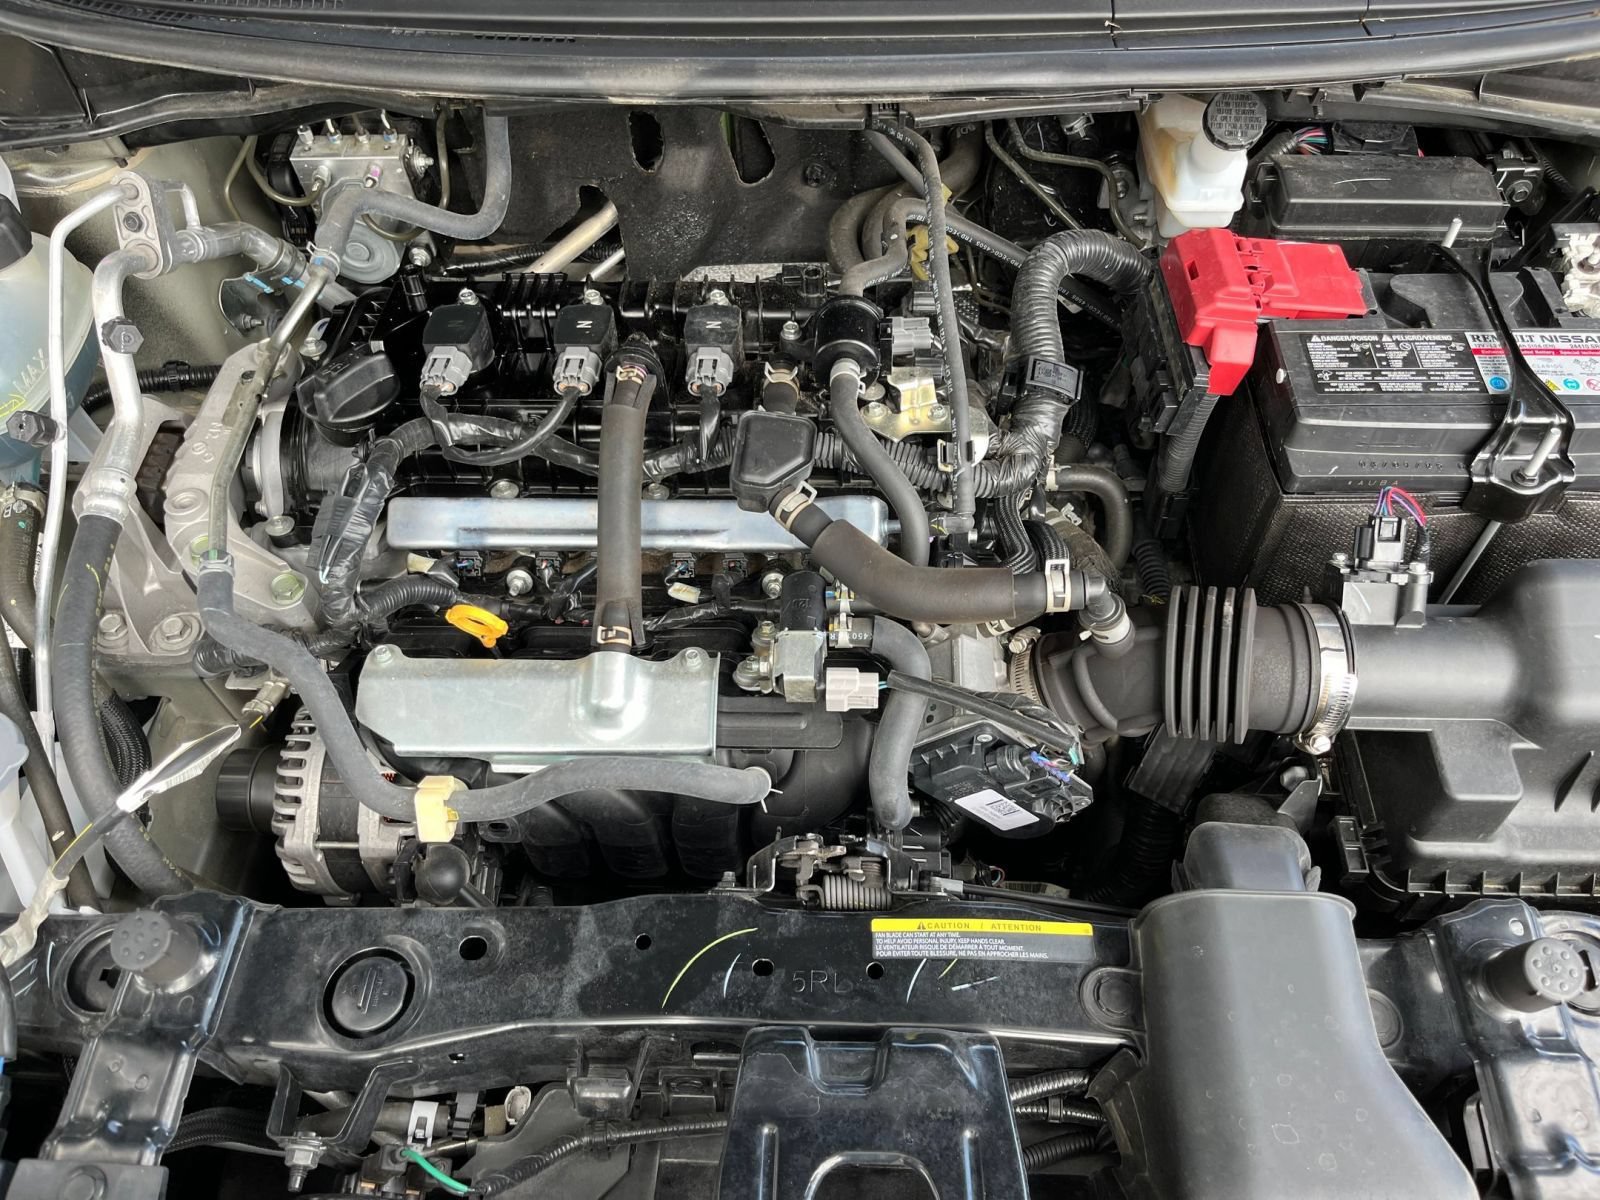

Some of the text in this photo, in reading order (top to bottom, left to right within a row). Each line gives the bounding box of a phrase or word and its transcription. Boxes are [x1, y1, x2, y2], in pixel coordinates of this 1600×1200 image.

[1539, 335, 1600, 343] NISSA
[927, 922, 970, 930] CAUTION
[991, 923, 1042, 932] ATTENTION
